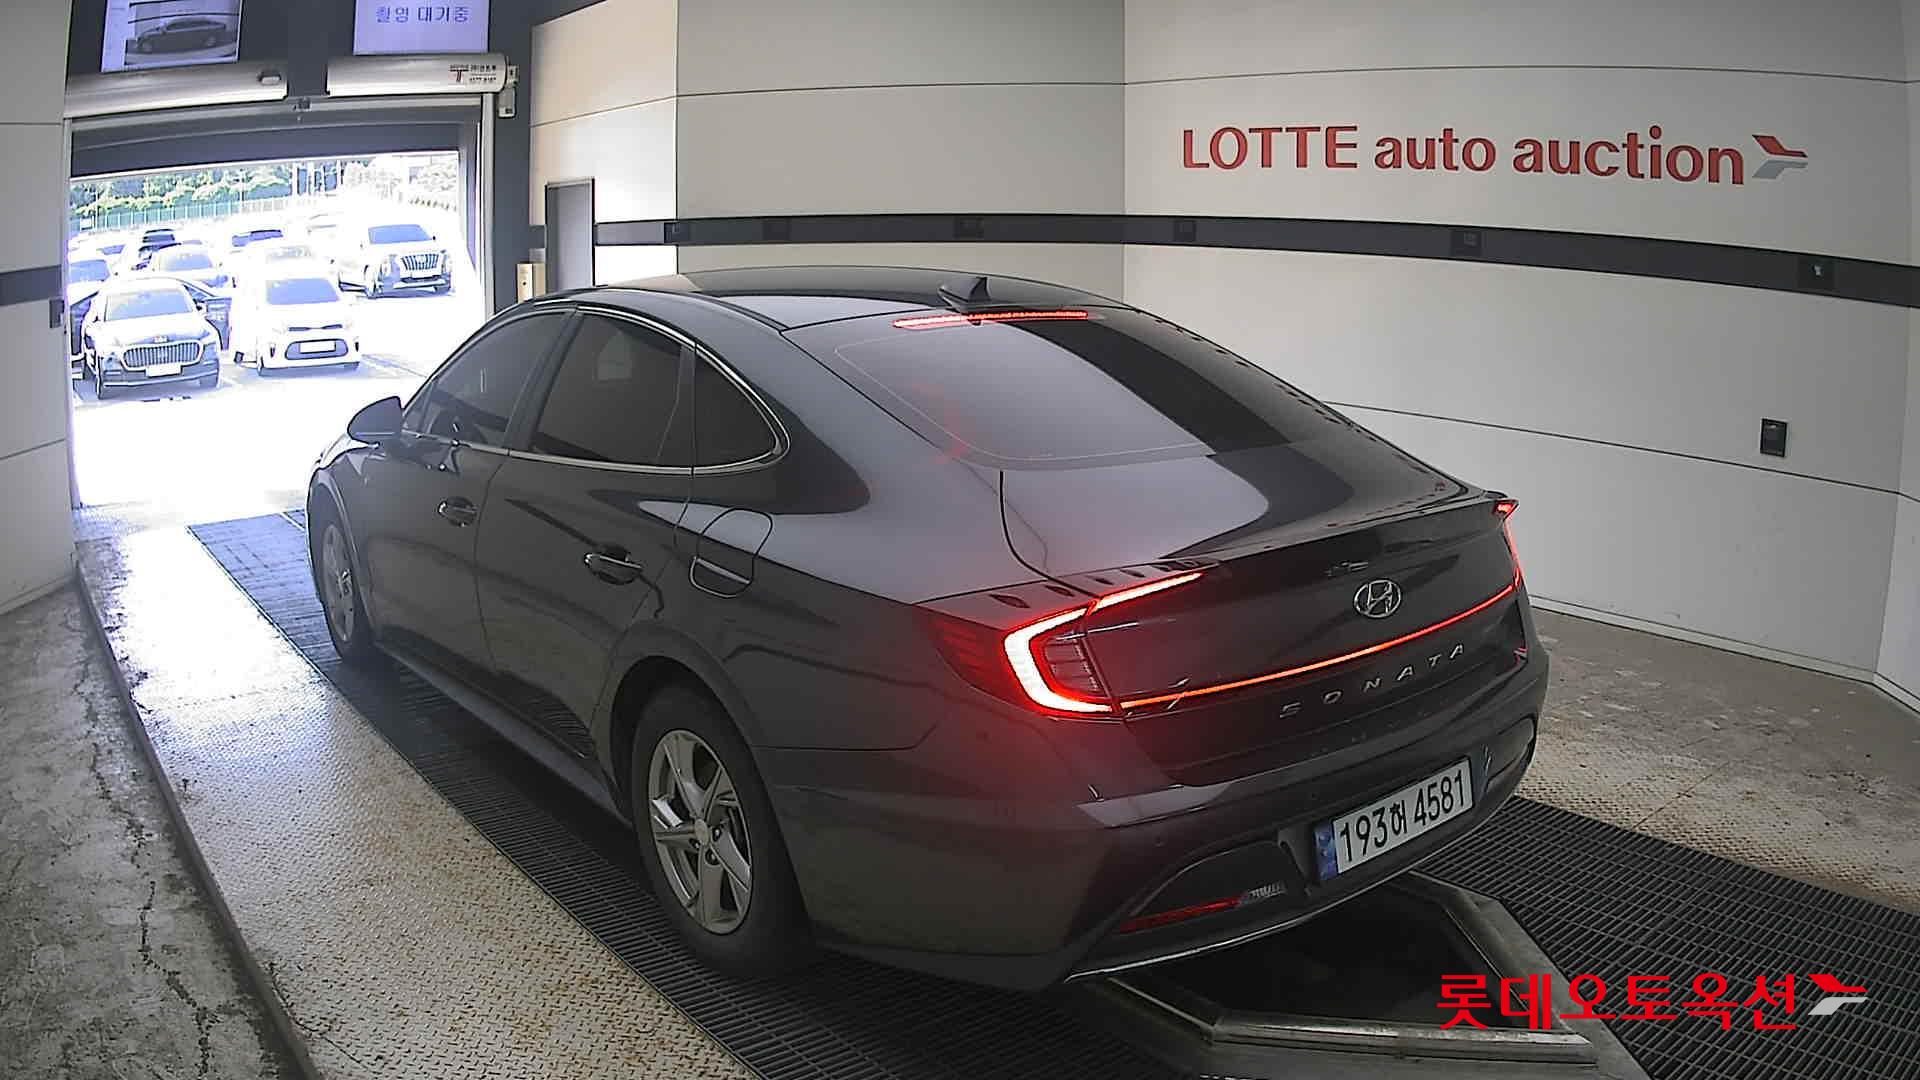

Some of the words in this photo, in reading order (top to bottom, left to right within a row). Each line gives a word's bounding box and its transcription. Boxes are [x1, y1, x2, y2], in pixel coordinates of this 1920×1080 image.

[417, 6, 469, 23] 대기중
[1183, 125, 1358, 169] LOTTE
[1374, 127, 1496, 171] auto
[1512, 126, 1745, 185] auction
[1279, 643, 1464, 718] SONATA
[1339, 799, 1408, 862] 193허
[1413, 769, 1465, 826] 4581
